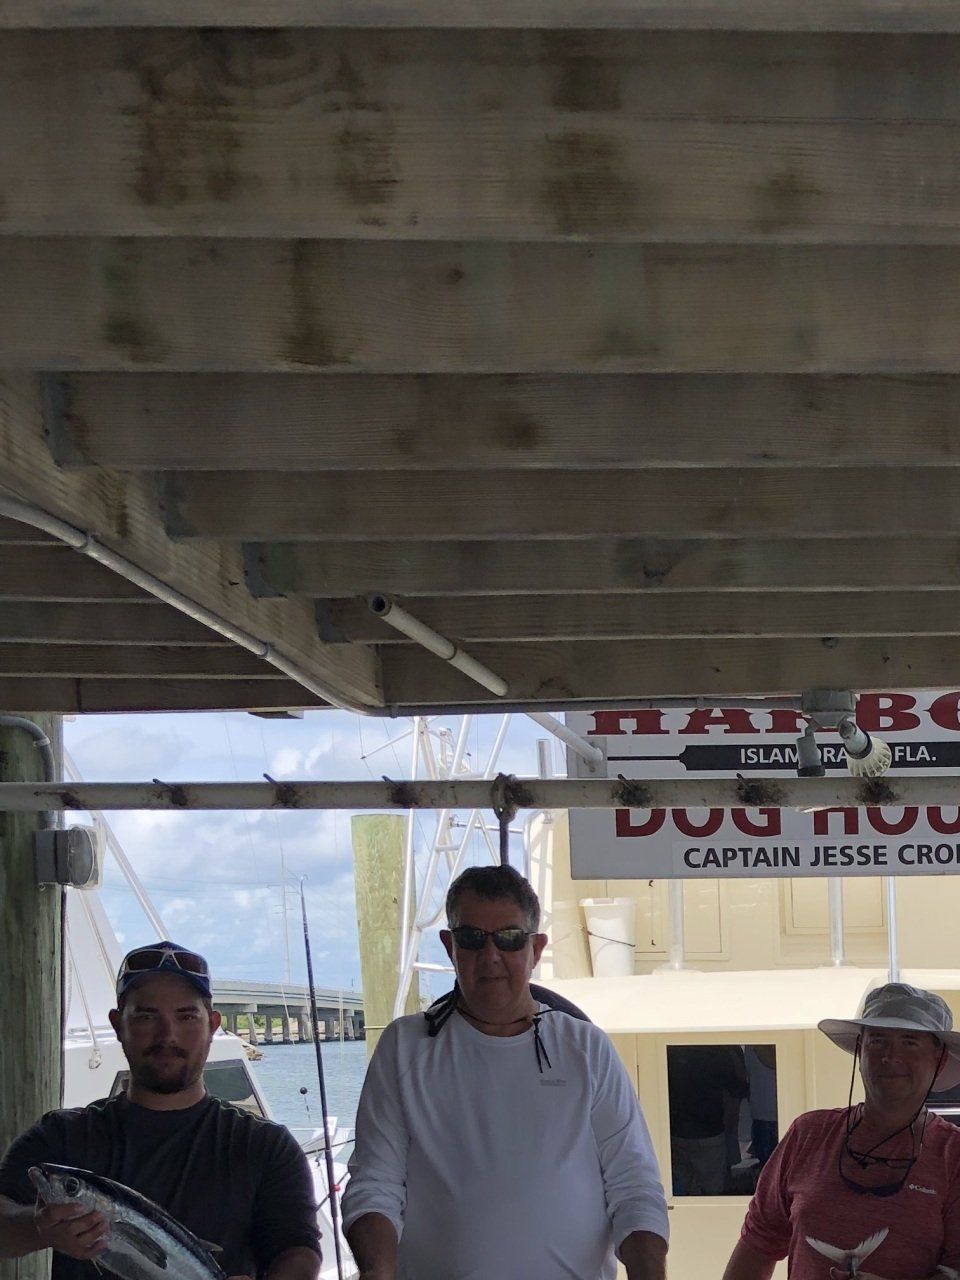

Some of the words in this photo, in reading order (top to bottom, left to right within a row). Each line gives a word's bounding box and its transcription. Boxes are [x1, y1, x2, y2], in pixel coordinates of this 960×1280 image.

[894, 746, 937, 763] FLA.
[683, 847, 800, 869] CAPTAIN
[810, 844, 888, 867] JESSE
